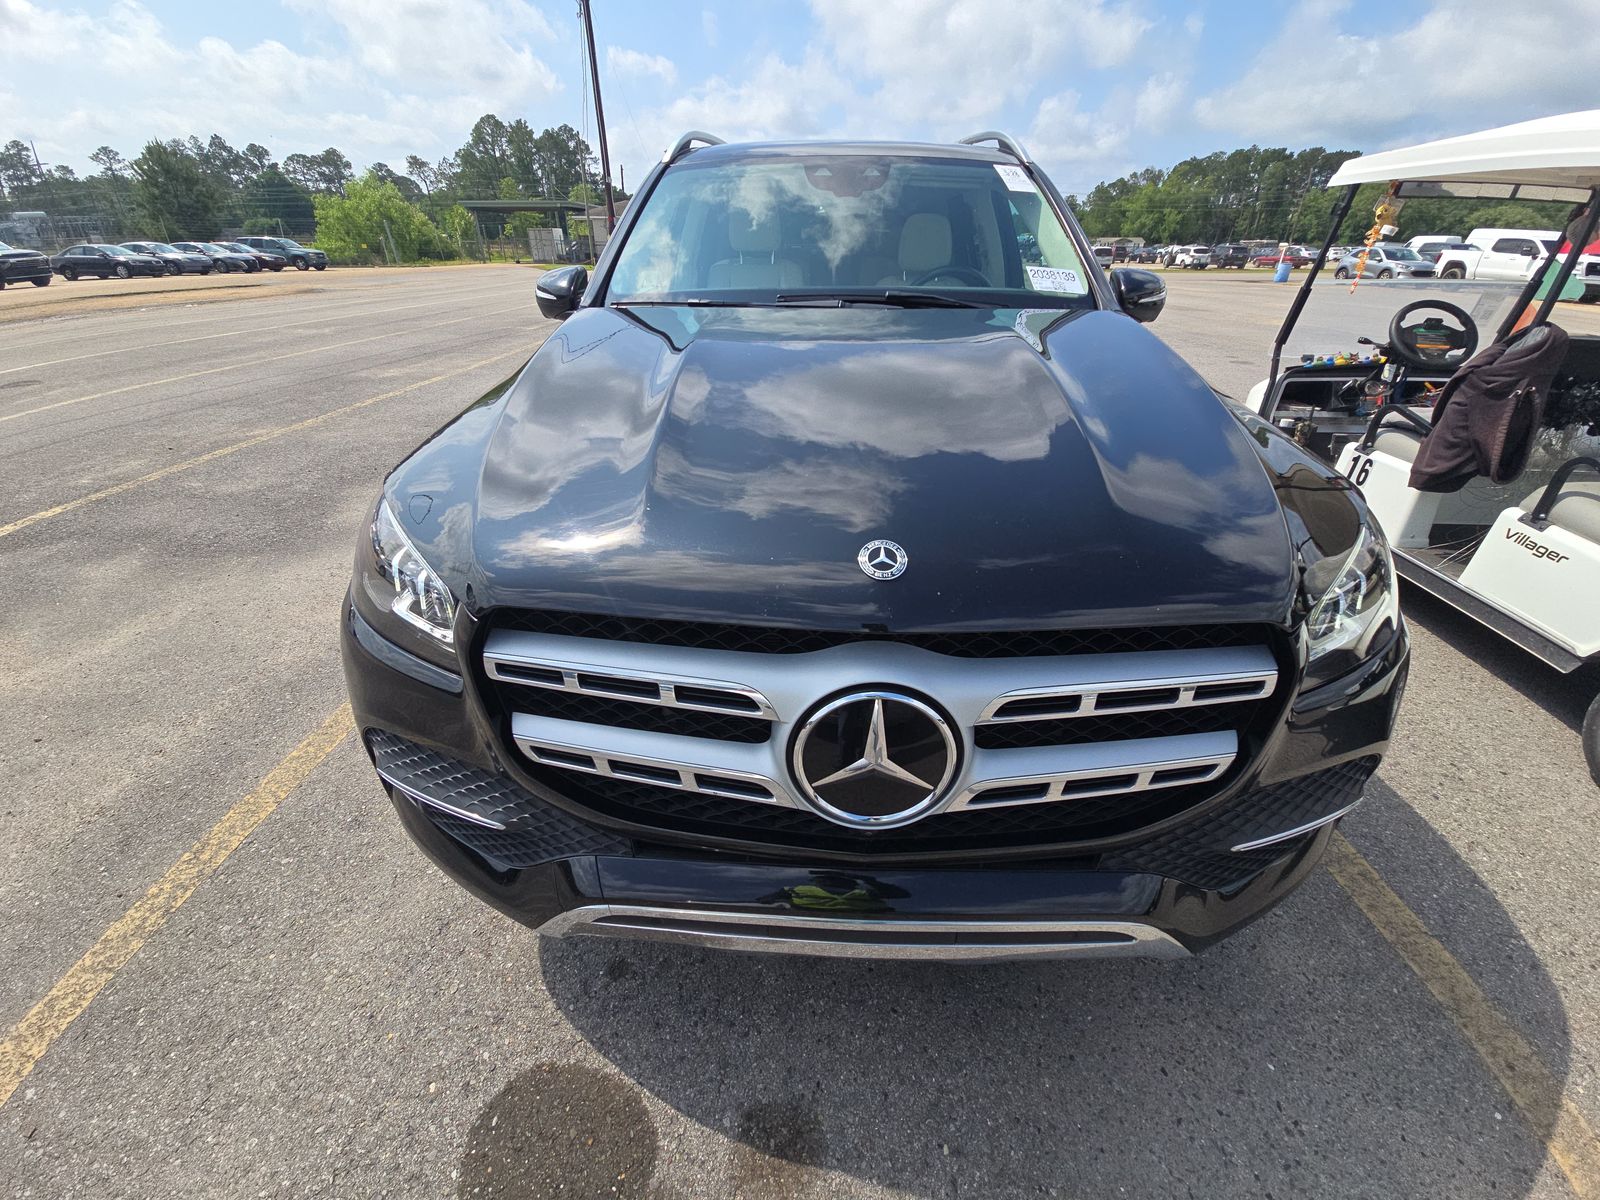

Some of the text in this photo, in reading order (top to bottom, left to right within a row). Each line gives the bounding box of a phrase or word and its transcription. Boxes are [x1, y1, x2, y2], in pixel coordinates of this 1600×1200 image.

[1030, 269, 1075, 282] 2038139
[1347, 455, 1374, 487] 16
[1505, 528, 1570, 563] Villager
